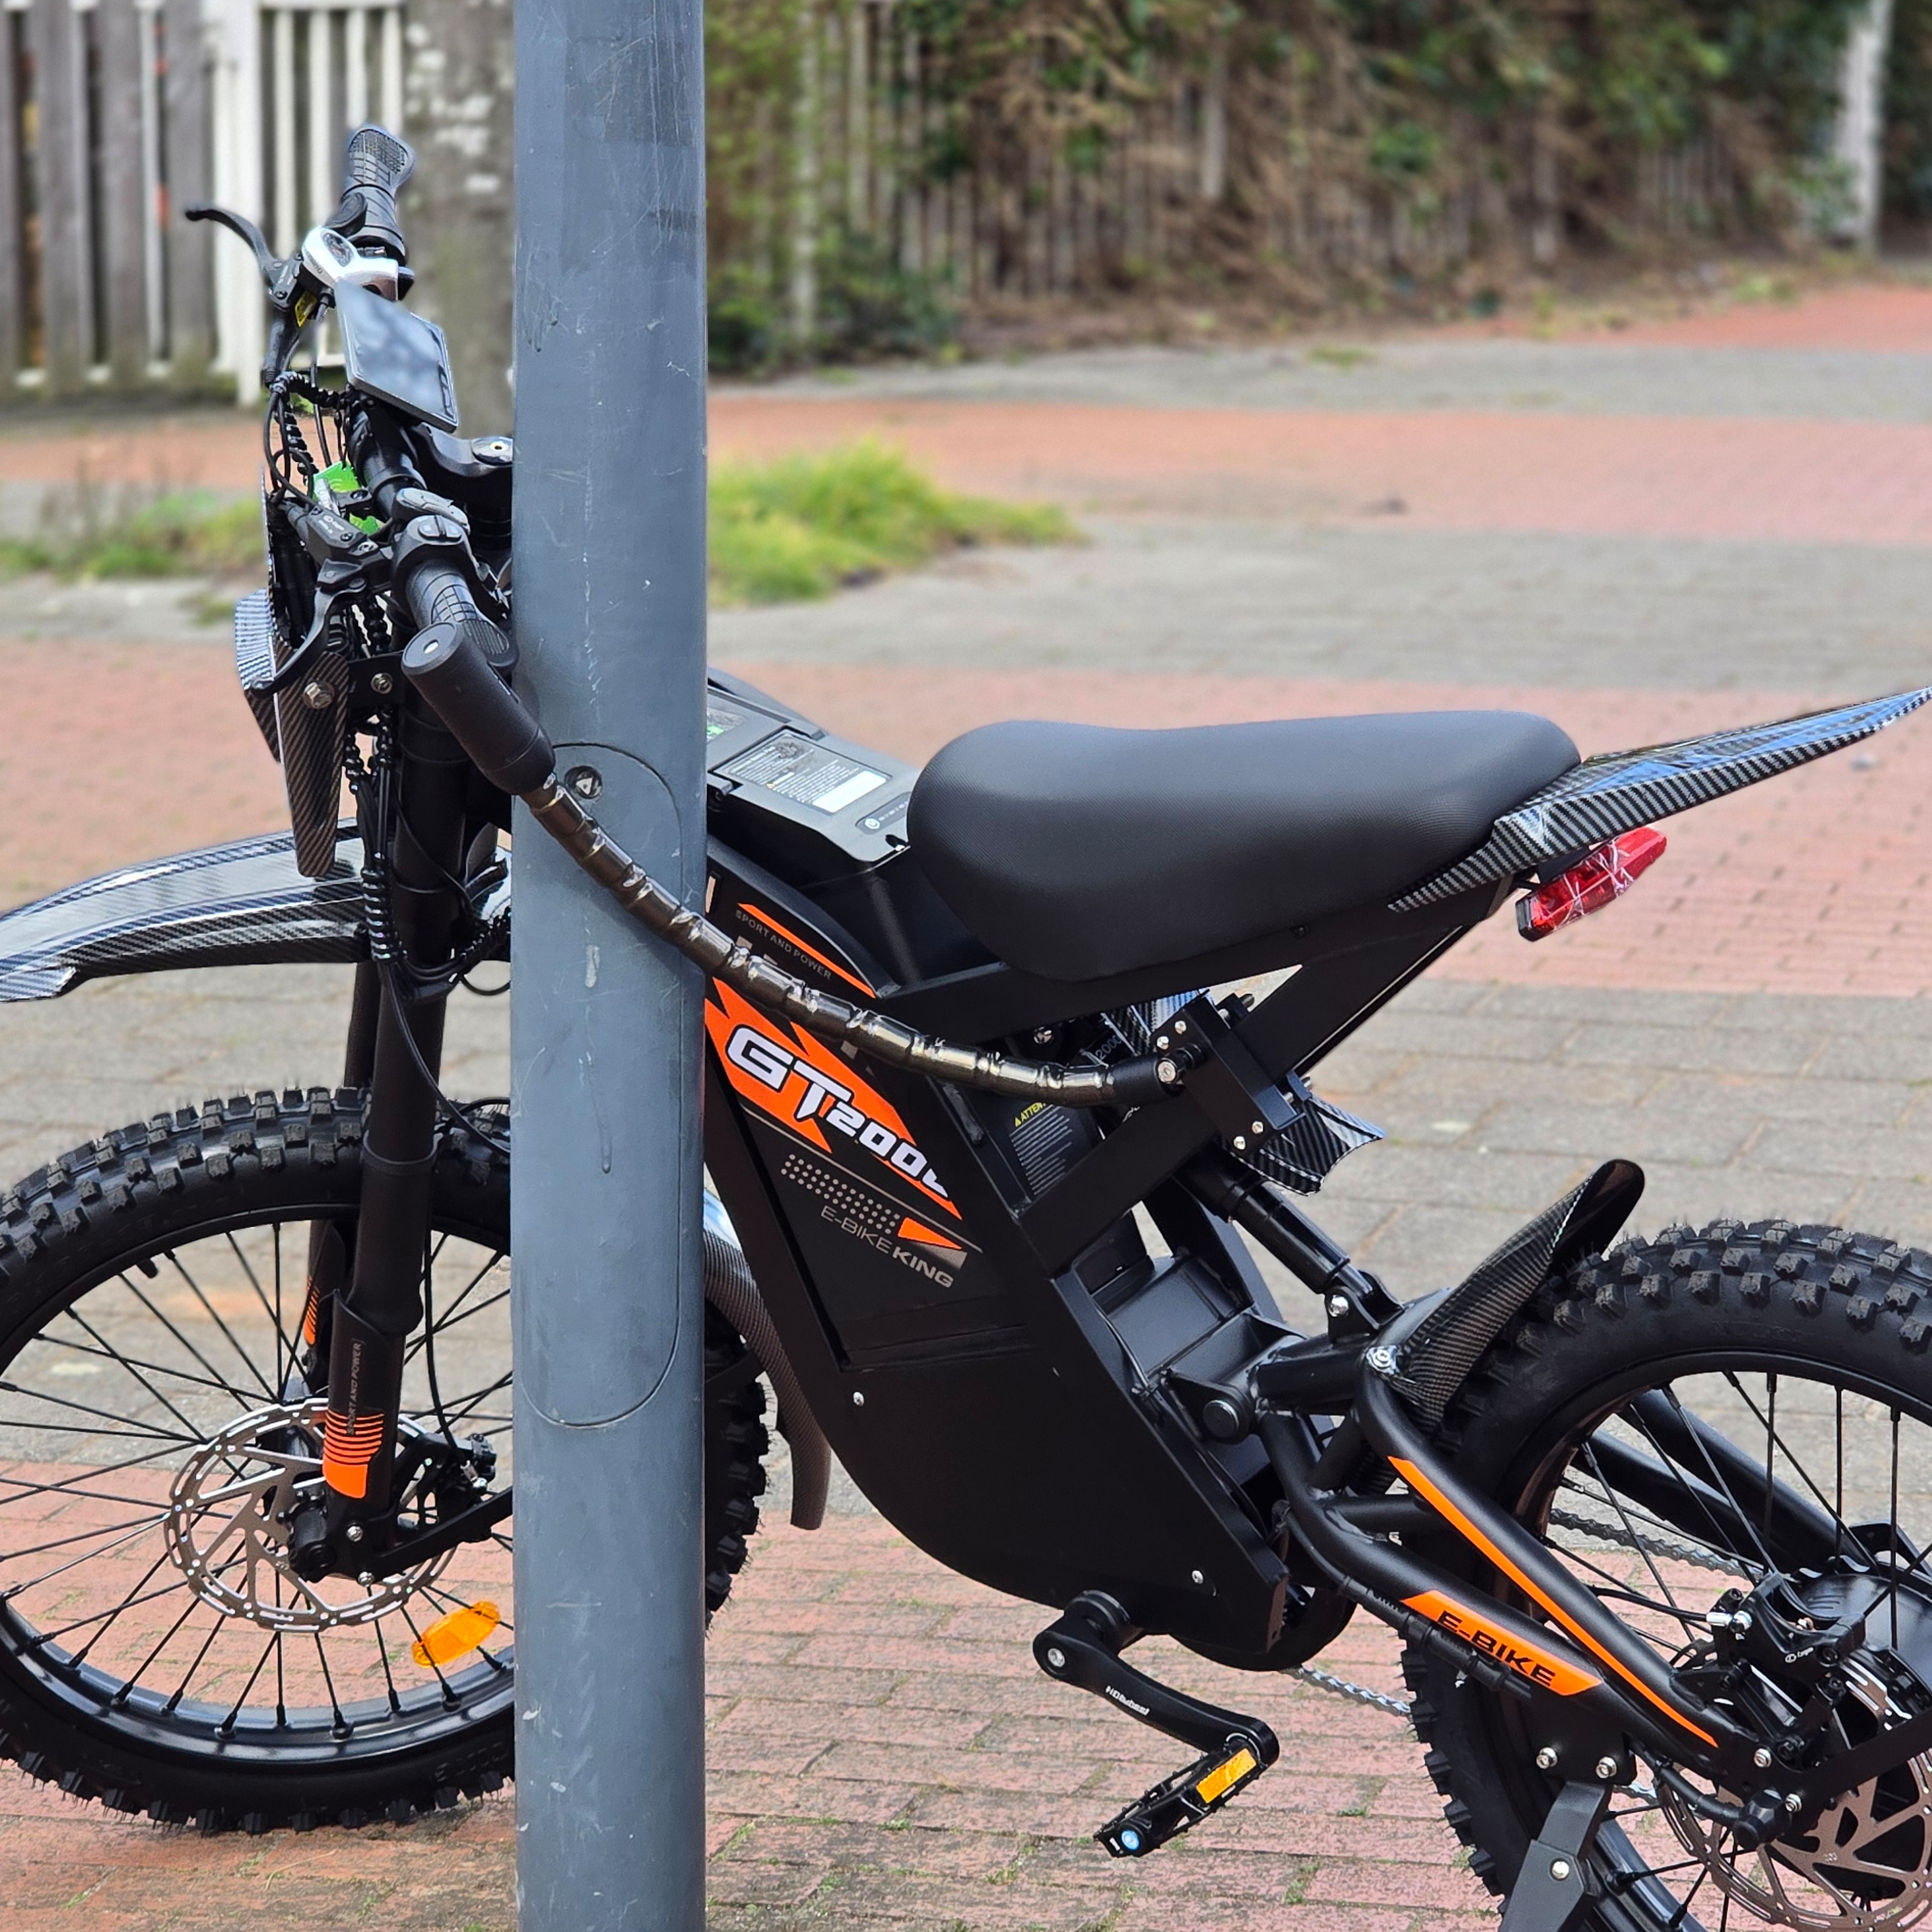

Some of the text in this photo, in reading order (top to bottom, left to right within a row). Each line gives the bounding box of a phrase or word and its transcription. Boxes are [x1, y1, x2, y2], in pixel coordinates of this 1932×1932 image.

[736, 910, 832, 980] SPORT AND POWER
[821, 1205, 954, 1288] E-BIKE KING
[347, 1343, 362, 1435] SPORT AND POWER
[1437, 1610, 1556, 1687] E-BIKE
